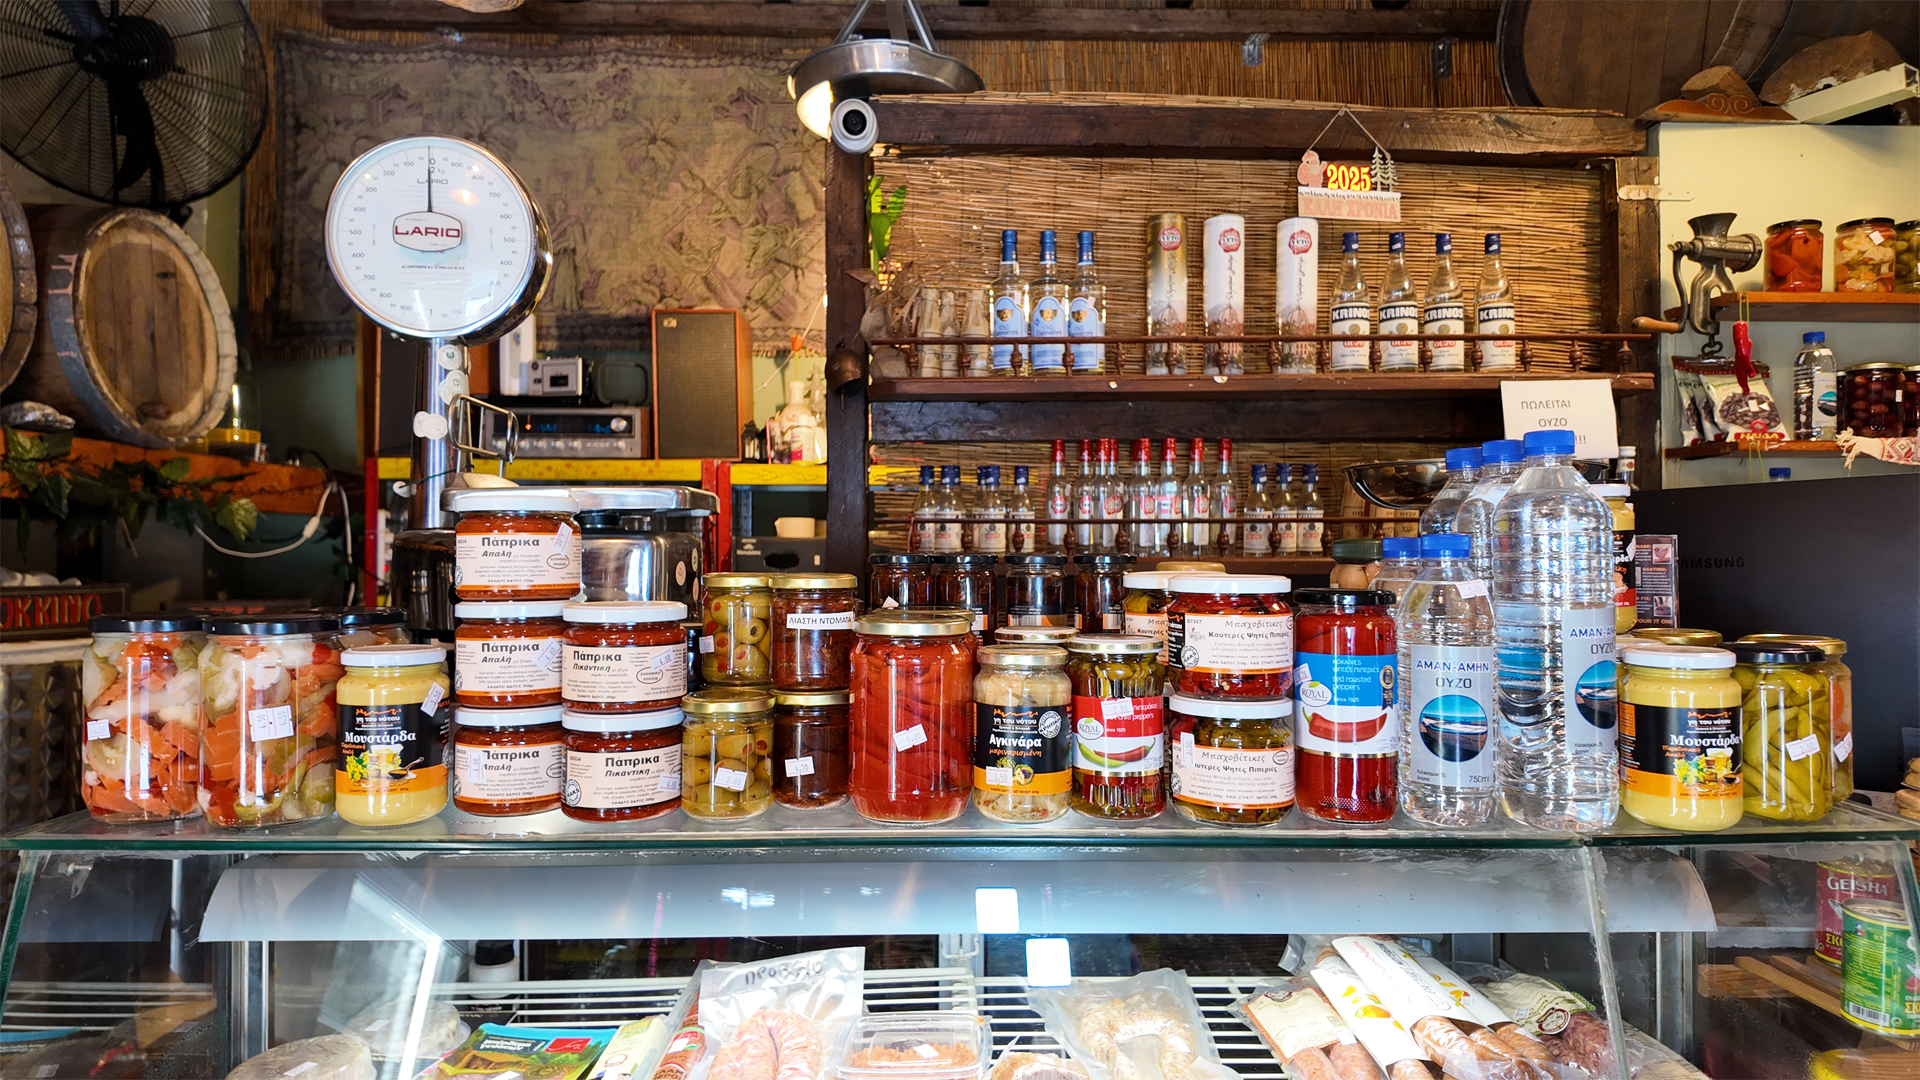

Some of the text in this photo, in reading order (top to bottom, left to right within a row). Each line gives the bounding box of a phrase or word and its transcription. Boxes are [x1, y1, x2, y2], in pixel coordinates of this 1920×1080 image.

[1327, 164, 1372, 192] 2025
[1304, 198, 1398, 220] ΚΑΛΗ ΧΡΟΝΙΑ
[395, 225, 460, 238] LARIO
[1521, 400, 1571, 410] ΠΩΛΕΙΤΑΙ
[1538, 418, 1567, 427] ΟΥΖΟ
[482, 536, 540, 548] Πάπρικα
[1208, 632, 1244, 640] Καυτερές
[482, 642, 539, 654] Πάπρικα
[481, 656, 512, 664] Απαλή
[573, 650, 622, 663] Πάπρικα
[573, 663, 611, 672] Πικάντικη
[1435, 677, 1472, 688] ΟΥΖΟ
[431, 690, 440, 706] 3.50
[1302, 688, 1327, 698] ROYAL
[1132, 712, 1154, 721] peppers
[1079, 723, 1100, 733] ROYAL
[345, 730, 416, 745] Μουστάρδα
[907, 733, 921, 744] 5.00
[989, 734, 1042, 749] Αγκινάρα
[1670, 734, 1740, 748] Μουστάρδα
[989, 748, 1042, 757] μαριναρισμένη
[1202, 752, 1265, 763] Μπαχοβίτικες
[606, 755, 660, 768] Πάπρικα
[605, 769, 650, 777] Πικάντικη
[1223, 765, 1246, 773] Ψητές
[1469, 775, 1489, 783] 750ml
[1827, 876, 1888, 896] GEISHA
